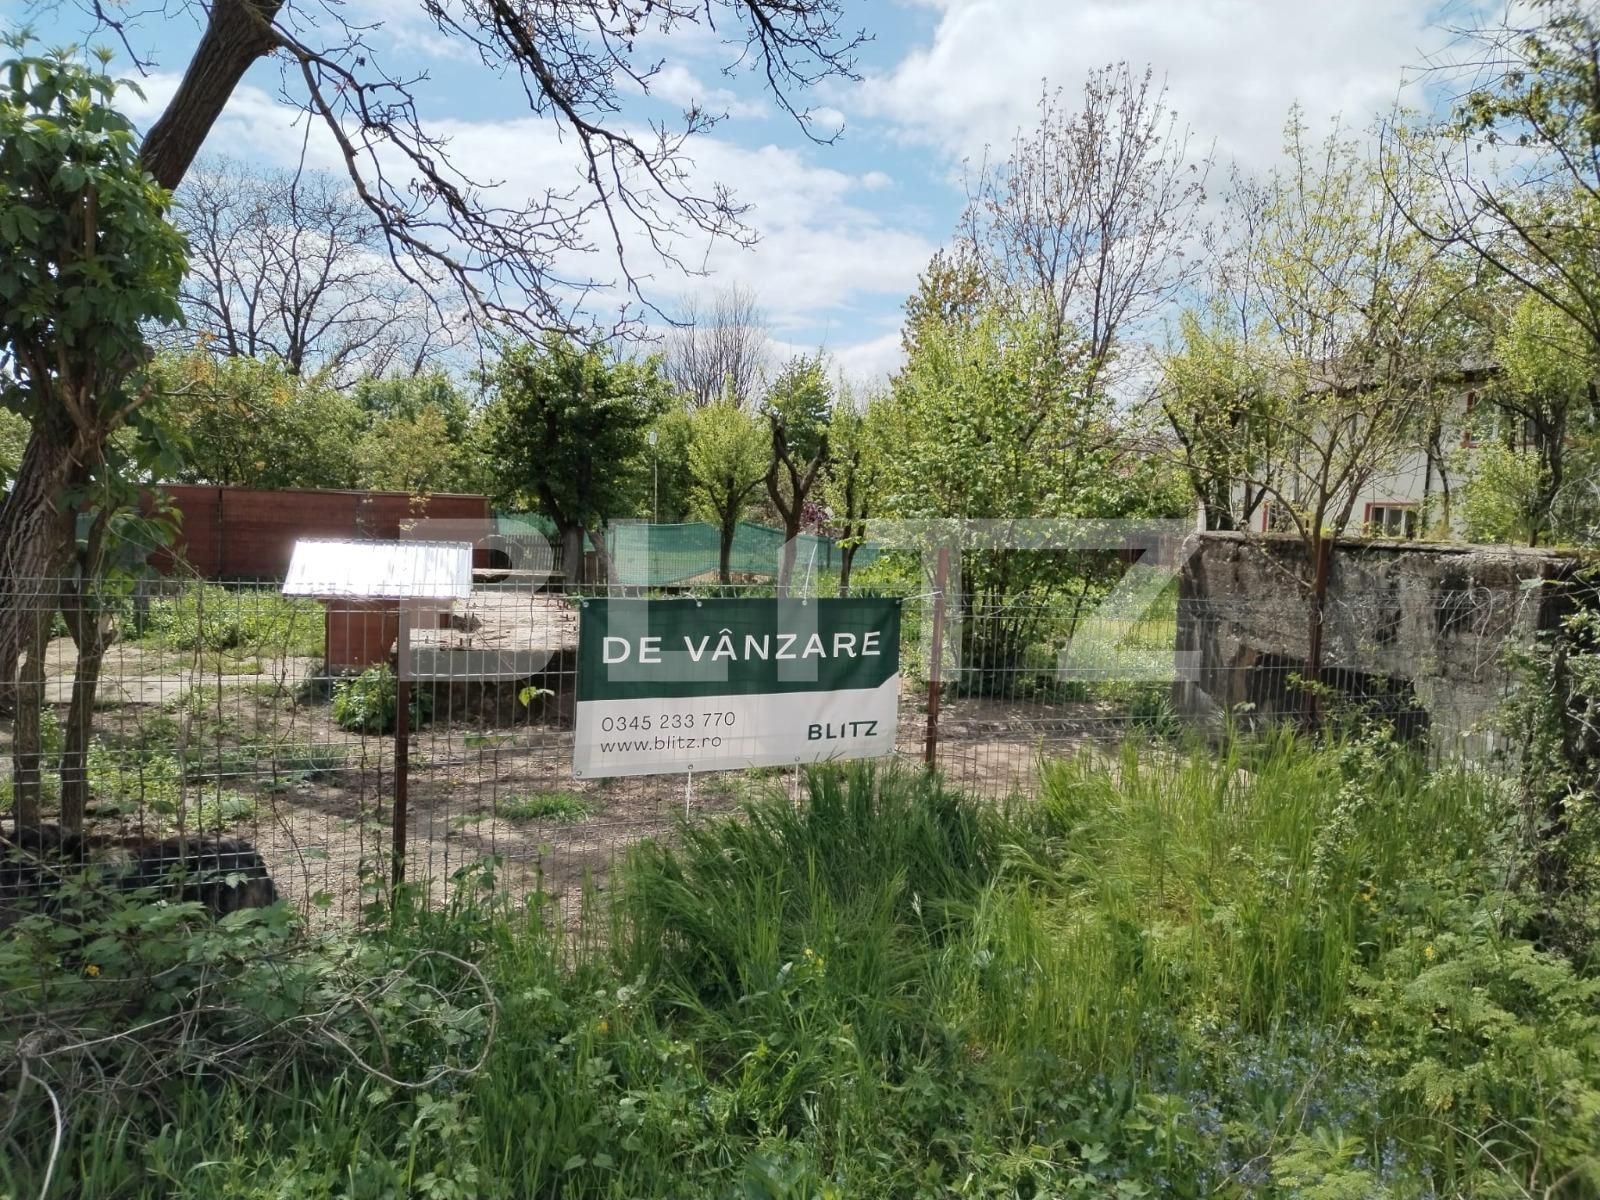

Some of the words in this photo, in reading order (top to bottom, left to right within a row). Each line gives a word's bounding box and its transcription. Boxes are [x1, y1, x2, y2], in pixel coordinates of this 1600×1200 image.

[602, 636, 662, 664] DE
[684, 628, 881, 662] VÂNZARE
[601, 715, 652, 732] 0345
[660, 714, 694, 729] 233
[703, 711, 736, 727] 770
[808, 720, 878, 741] BLITZ
[600, 735, 722, 753] www.blitz.ro
